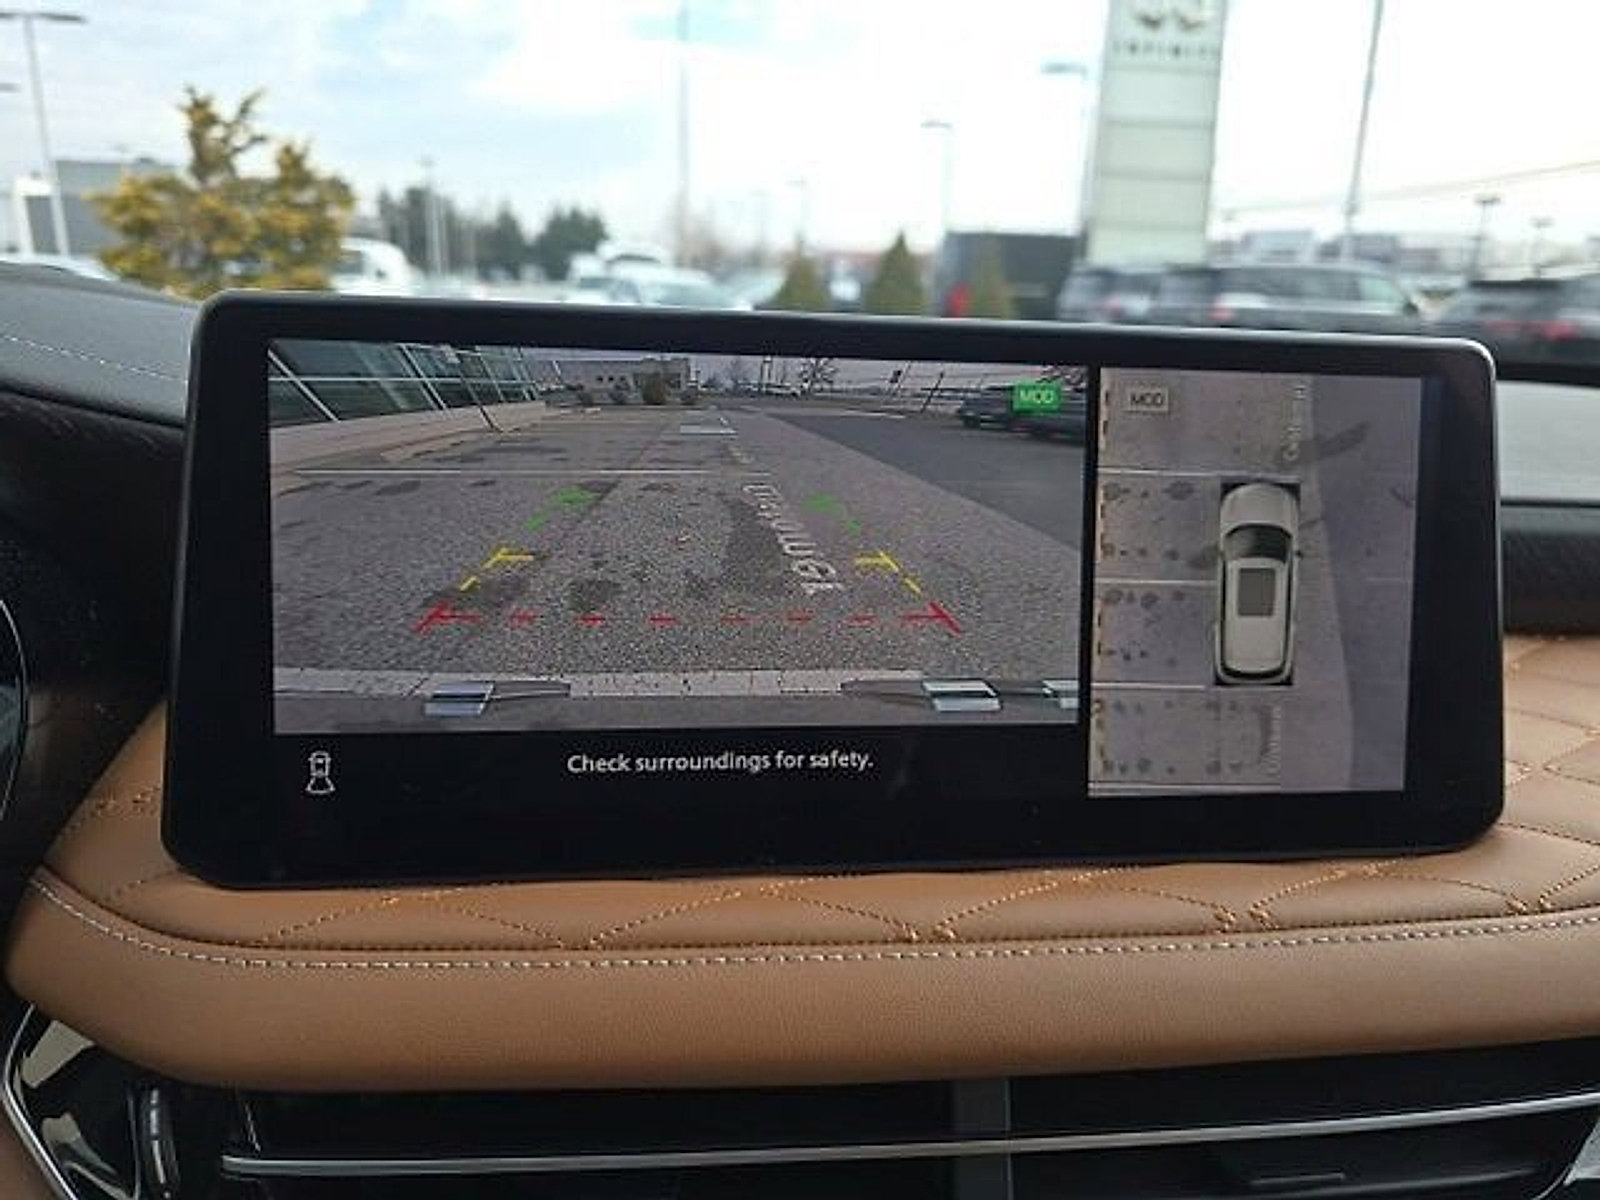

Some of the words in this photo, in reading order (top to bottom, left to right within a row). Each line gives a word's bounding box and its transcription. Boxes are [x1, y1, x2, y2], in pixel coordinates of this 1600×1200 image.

[1019, 389, 1055, 404] MOD
[1129, 391, 1164, 407] MOD
[567, 753, 630, 773] Check
[635, 751, 770, 774] surroundings
[775, 750, 803, 768] for
[809, 750, 874, 772] safety.
